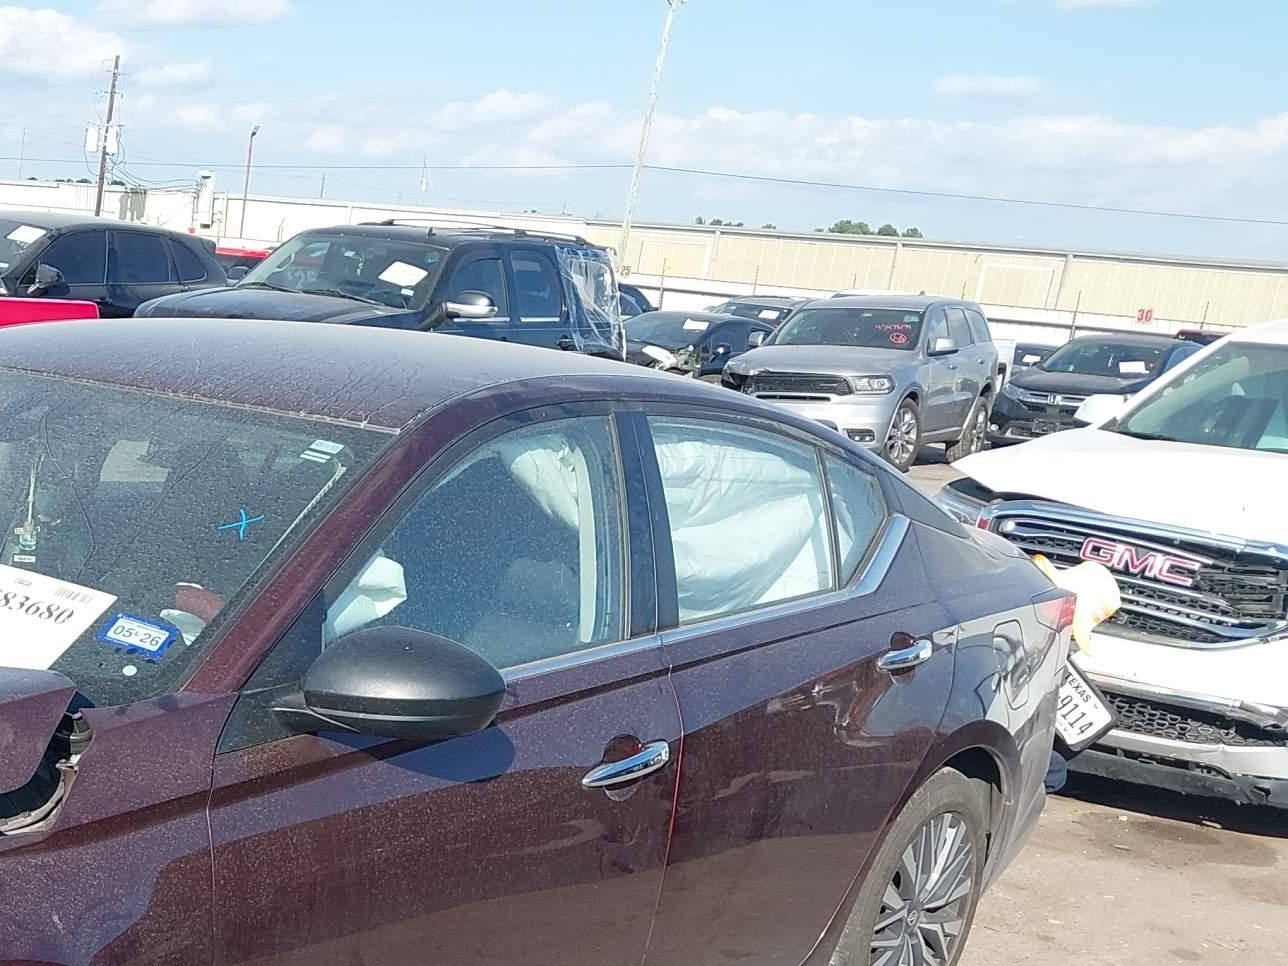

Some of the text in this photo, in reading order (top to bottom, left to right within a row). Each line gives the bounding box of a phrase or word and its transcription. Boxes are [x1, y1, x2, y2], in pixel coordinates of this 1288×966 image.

[1137, 308, 1153, 321] 30
[1079, 536, 1201, 587] GMC
[113, 625, 135, 638] 05
[139, 633, 161, 646] 26
[1064, 671, 1092, 703] TEXAS
